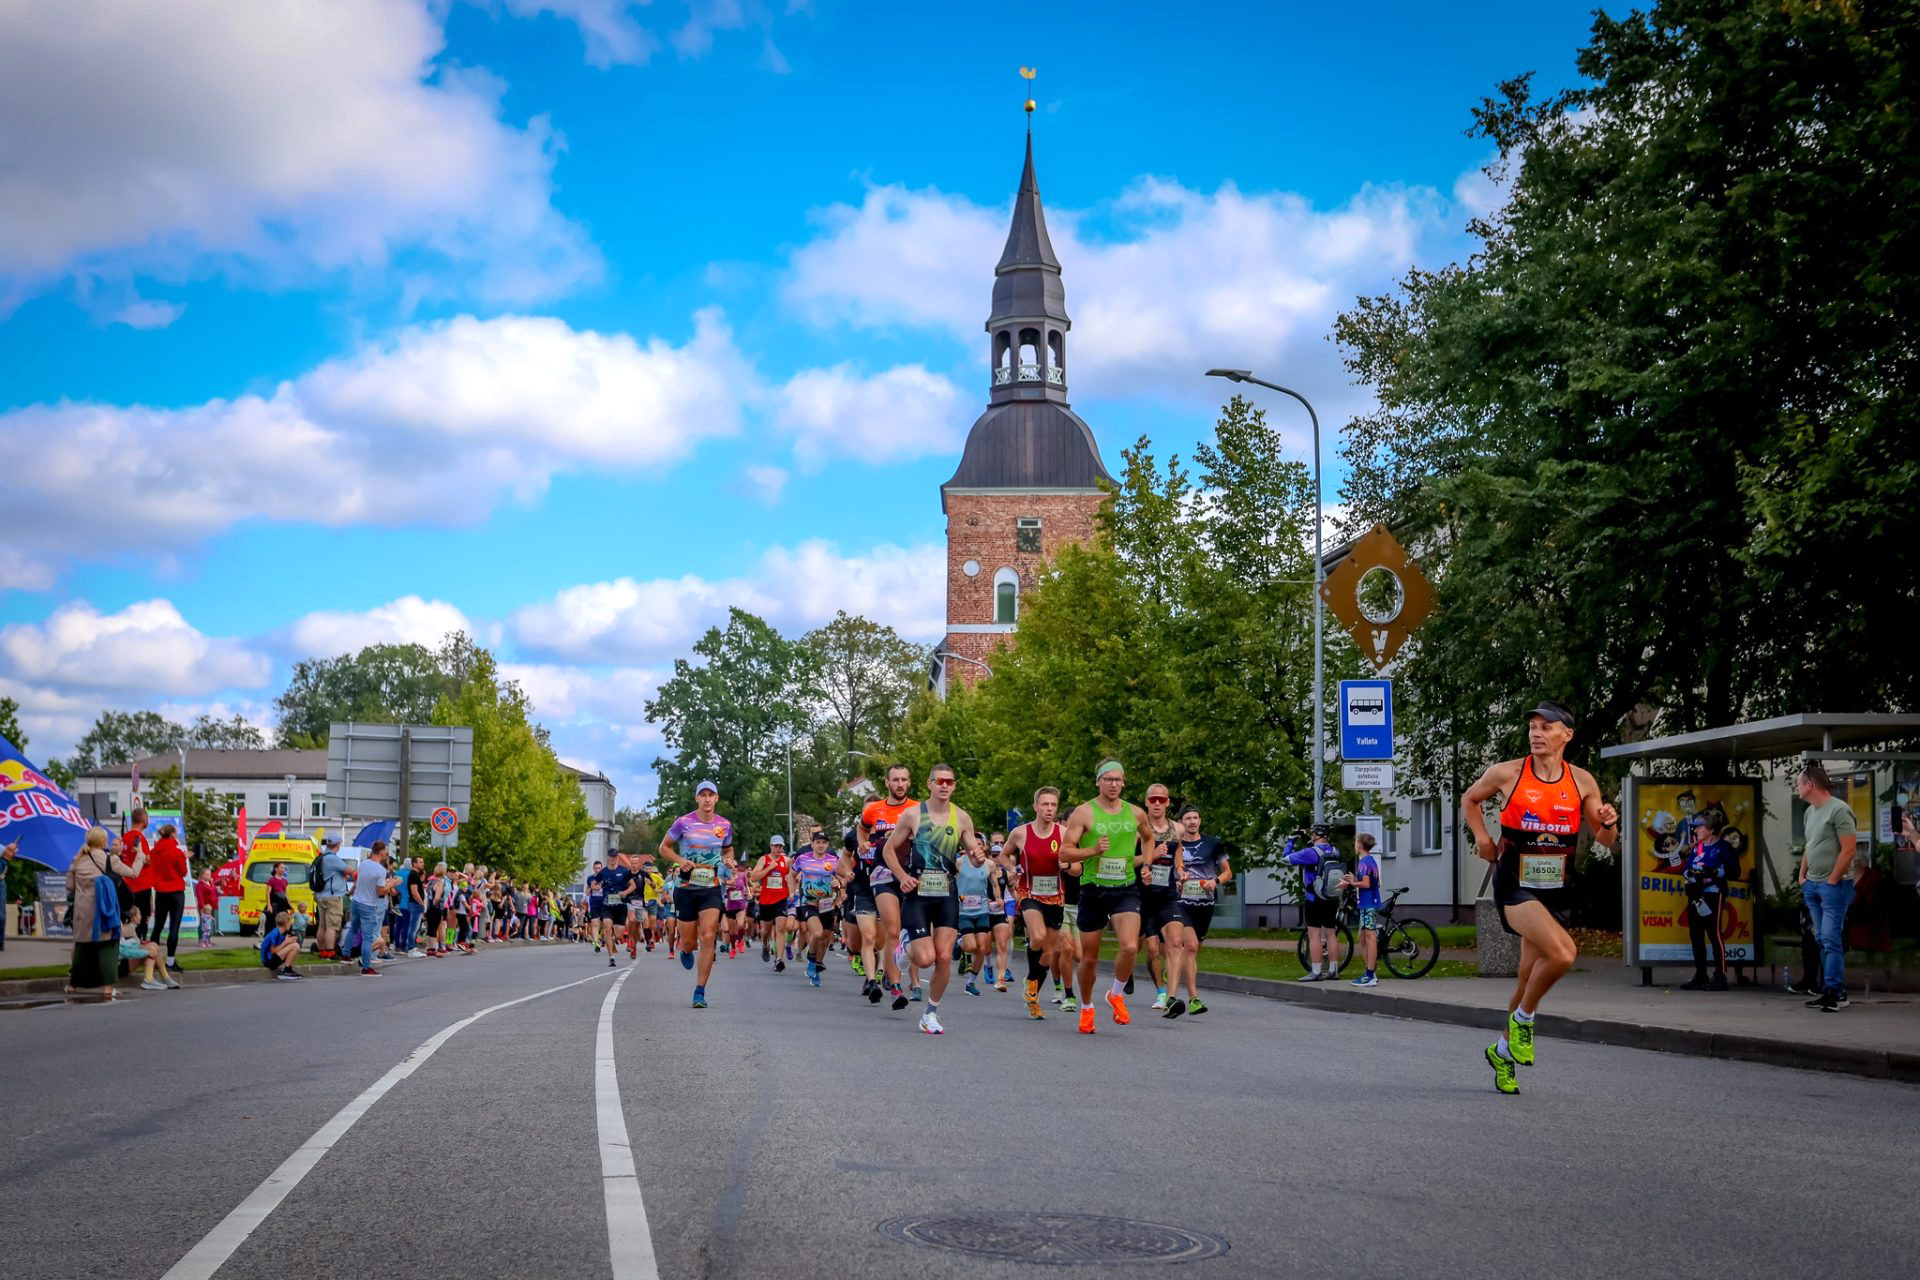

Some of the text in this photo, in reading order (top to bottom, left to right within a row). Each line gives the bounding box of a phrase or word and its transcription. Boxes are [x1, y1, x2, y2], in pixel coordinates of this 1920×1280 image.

[255, 843, 310, 851] AMBULANCE
[1532, 866, 1556, 874] 16502
[1642, 916, 1673, 927] VISAM
